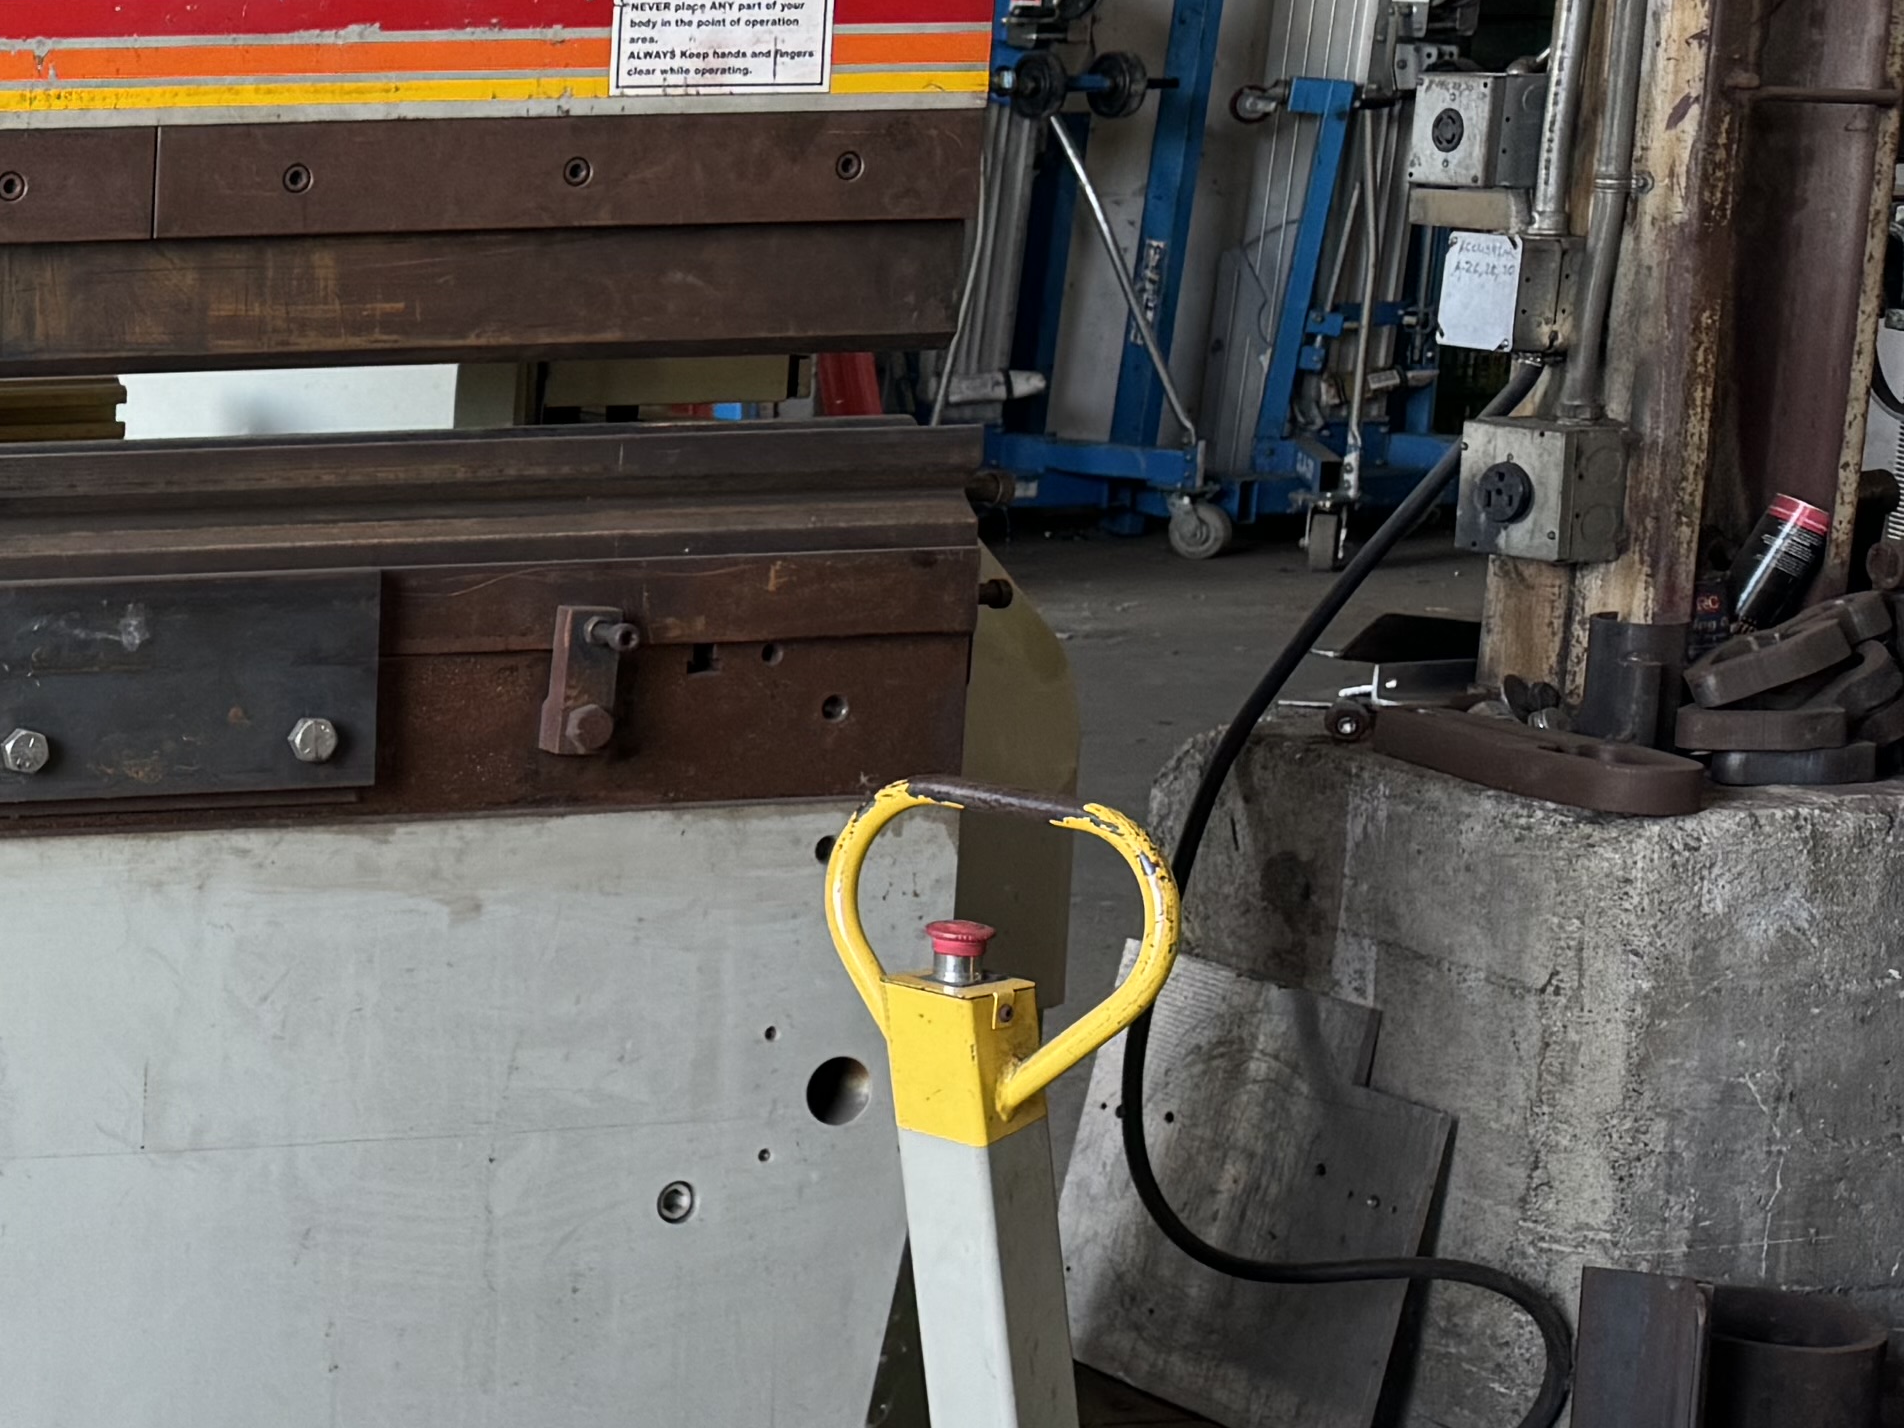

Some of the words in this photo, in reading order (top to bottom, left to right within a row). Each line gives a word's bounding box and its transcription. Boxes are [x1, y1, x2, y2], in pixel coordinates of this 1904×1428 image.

[628, 2, 670, 11] NEVER
[674, 2, 705, 14] place
[710, 1, 734, 10] ANY
[738, 2, 761, 11] part
[765, 0, 776, 9] of
[780, 2, 804, 12] your
[630, 18, 657, 29] body
[675, 18, 692, 27] the
[696, 18, 725, 28] point
[729, 17, 740, 26] of
[744, 17, 798, 28] operation
[629, 36, 658, 44] area.
[627, 48, 675, 59] ALWAYS
[680, 49, 709, 61] Keep
[712, 49, 746, 58] hands
[750, 49, 771, 58] and
[773, 48, 813, 61] fingers
[627, 67, 655, 76] clear
[660, 66, 690, 78] while
[694, 66, 751, 77] operating.
